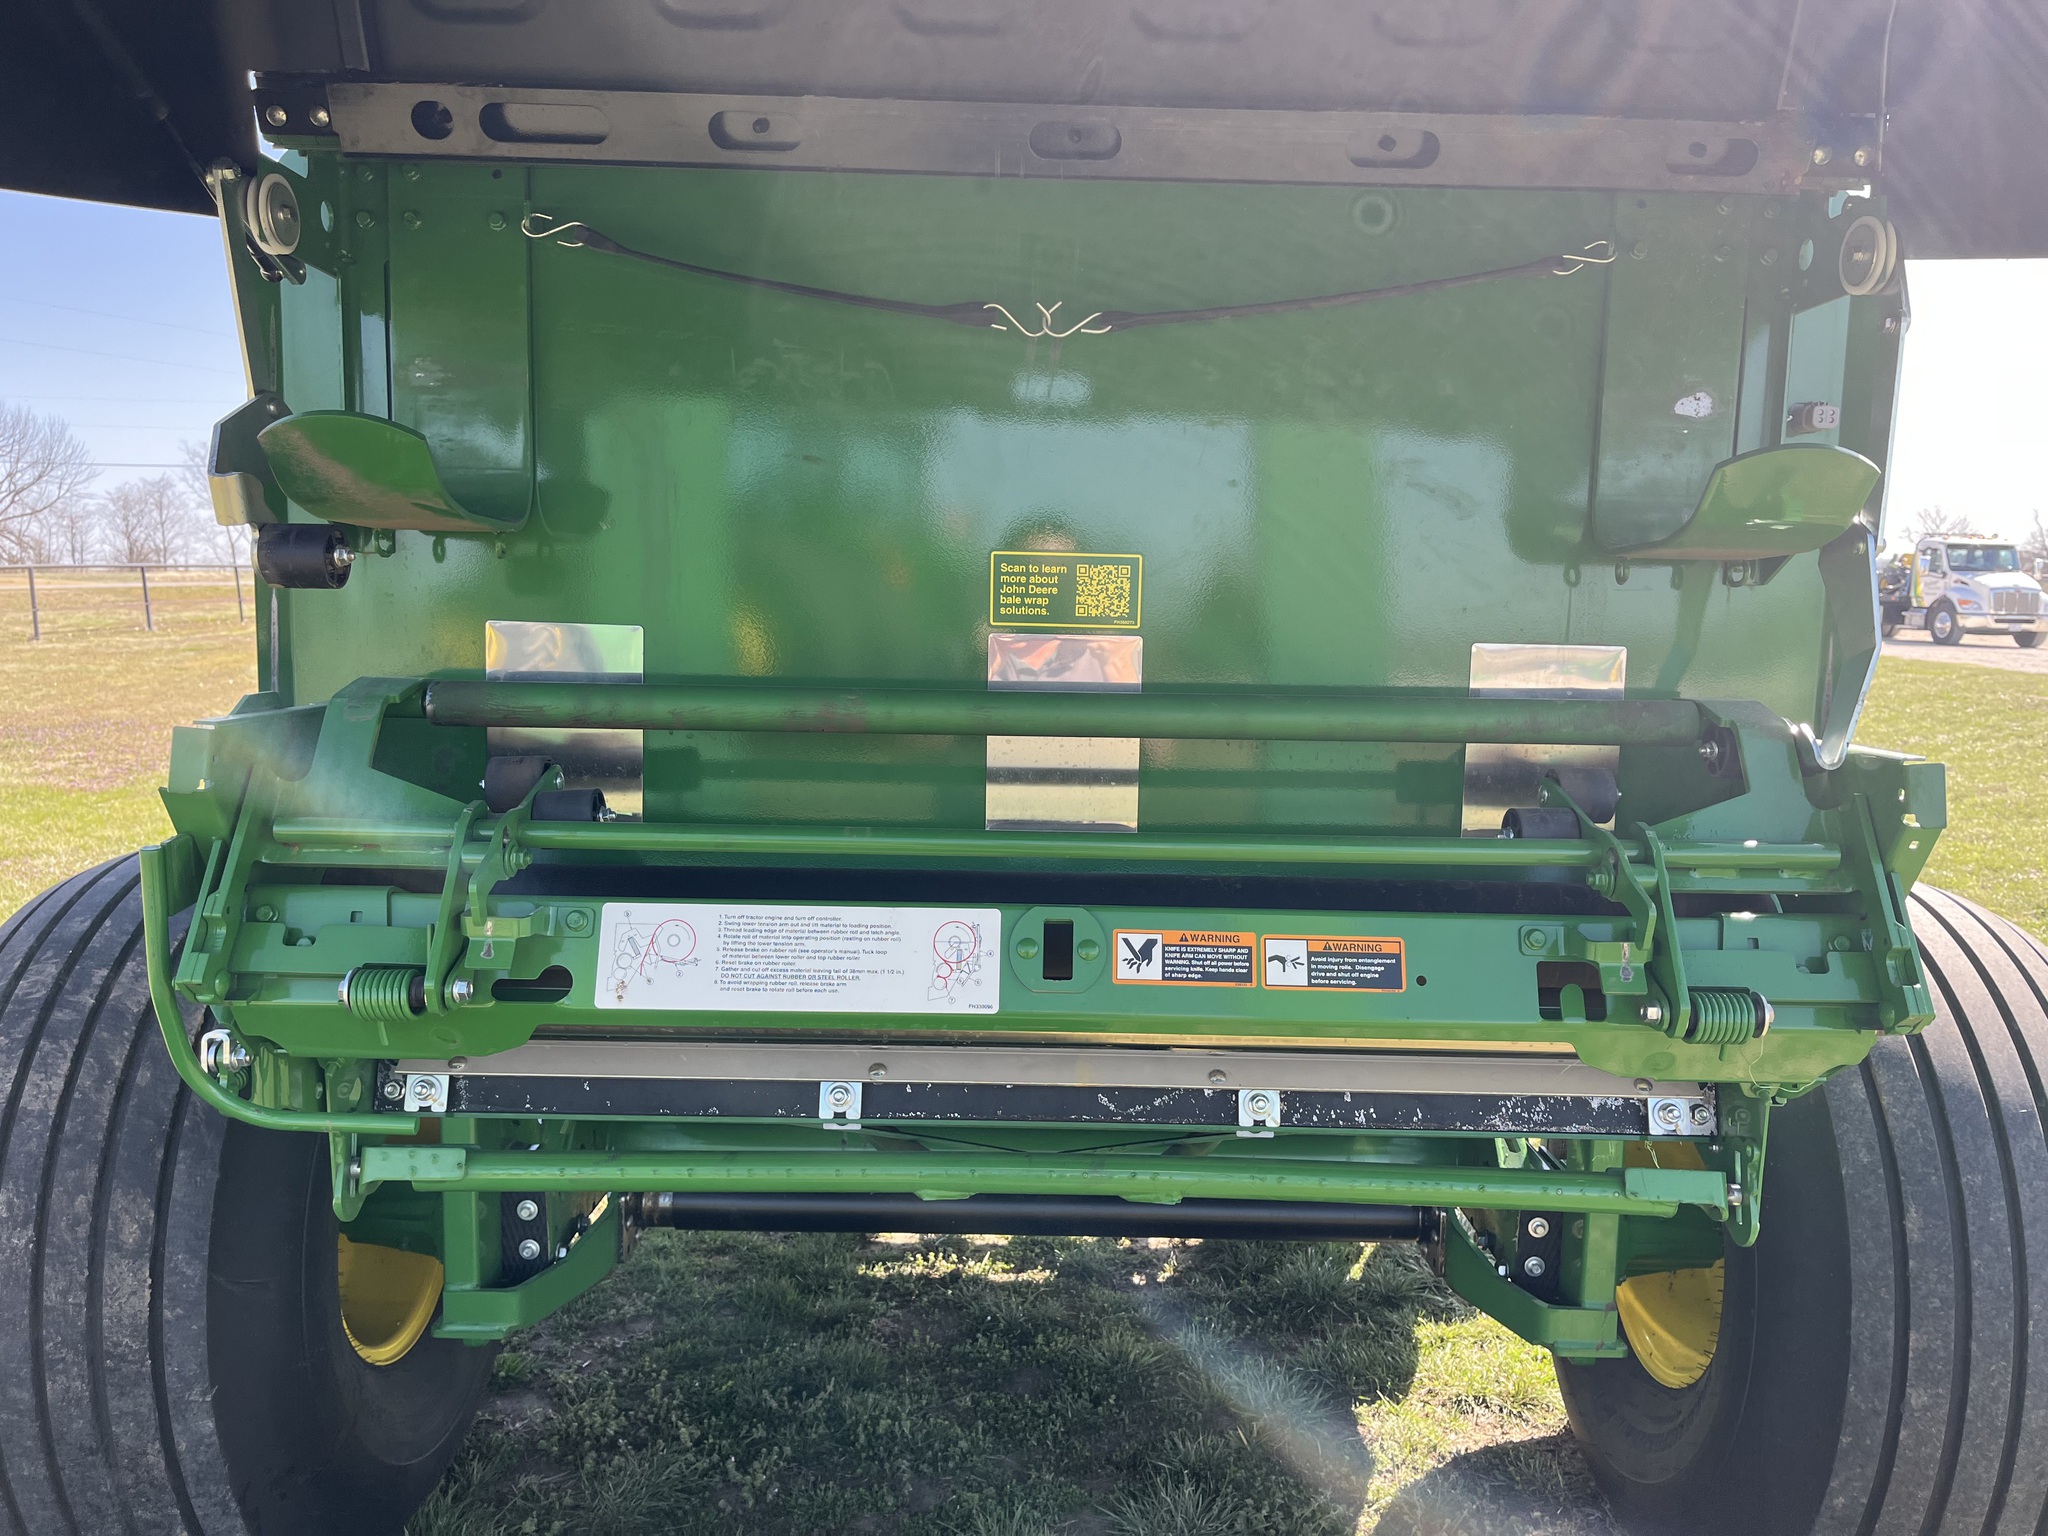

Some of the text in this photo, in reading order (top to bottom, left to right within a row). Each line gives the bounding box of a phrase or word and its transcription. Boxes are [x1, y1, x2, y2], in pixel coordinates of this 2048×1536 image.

[1000, 563, 1067, 573] Scan to learn
[1029, 574, 1058, 584] about
[1000, 585, 1058, 594] John Deere
[1000, 595, 1049, 606] bale wrap
[1000, 606, 1050, 615] solutions.
[1190, 934, 1240, 943] WARNING
[1332, 943, 1382, 952] WARNING
